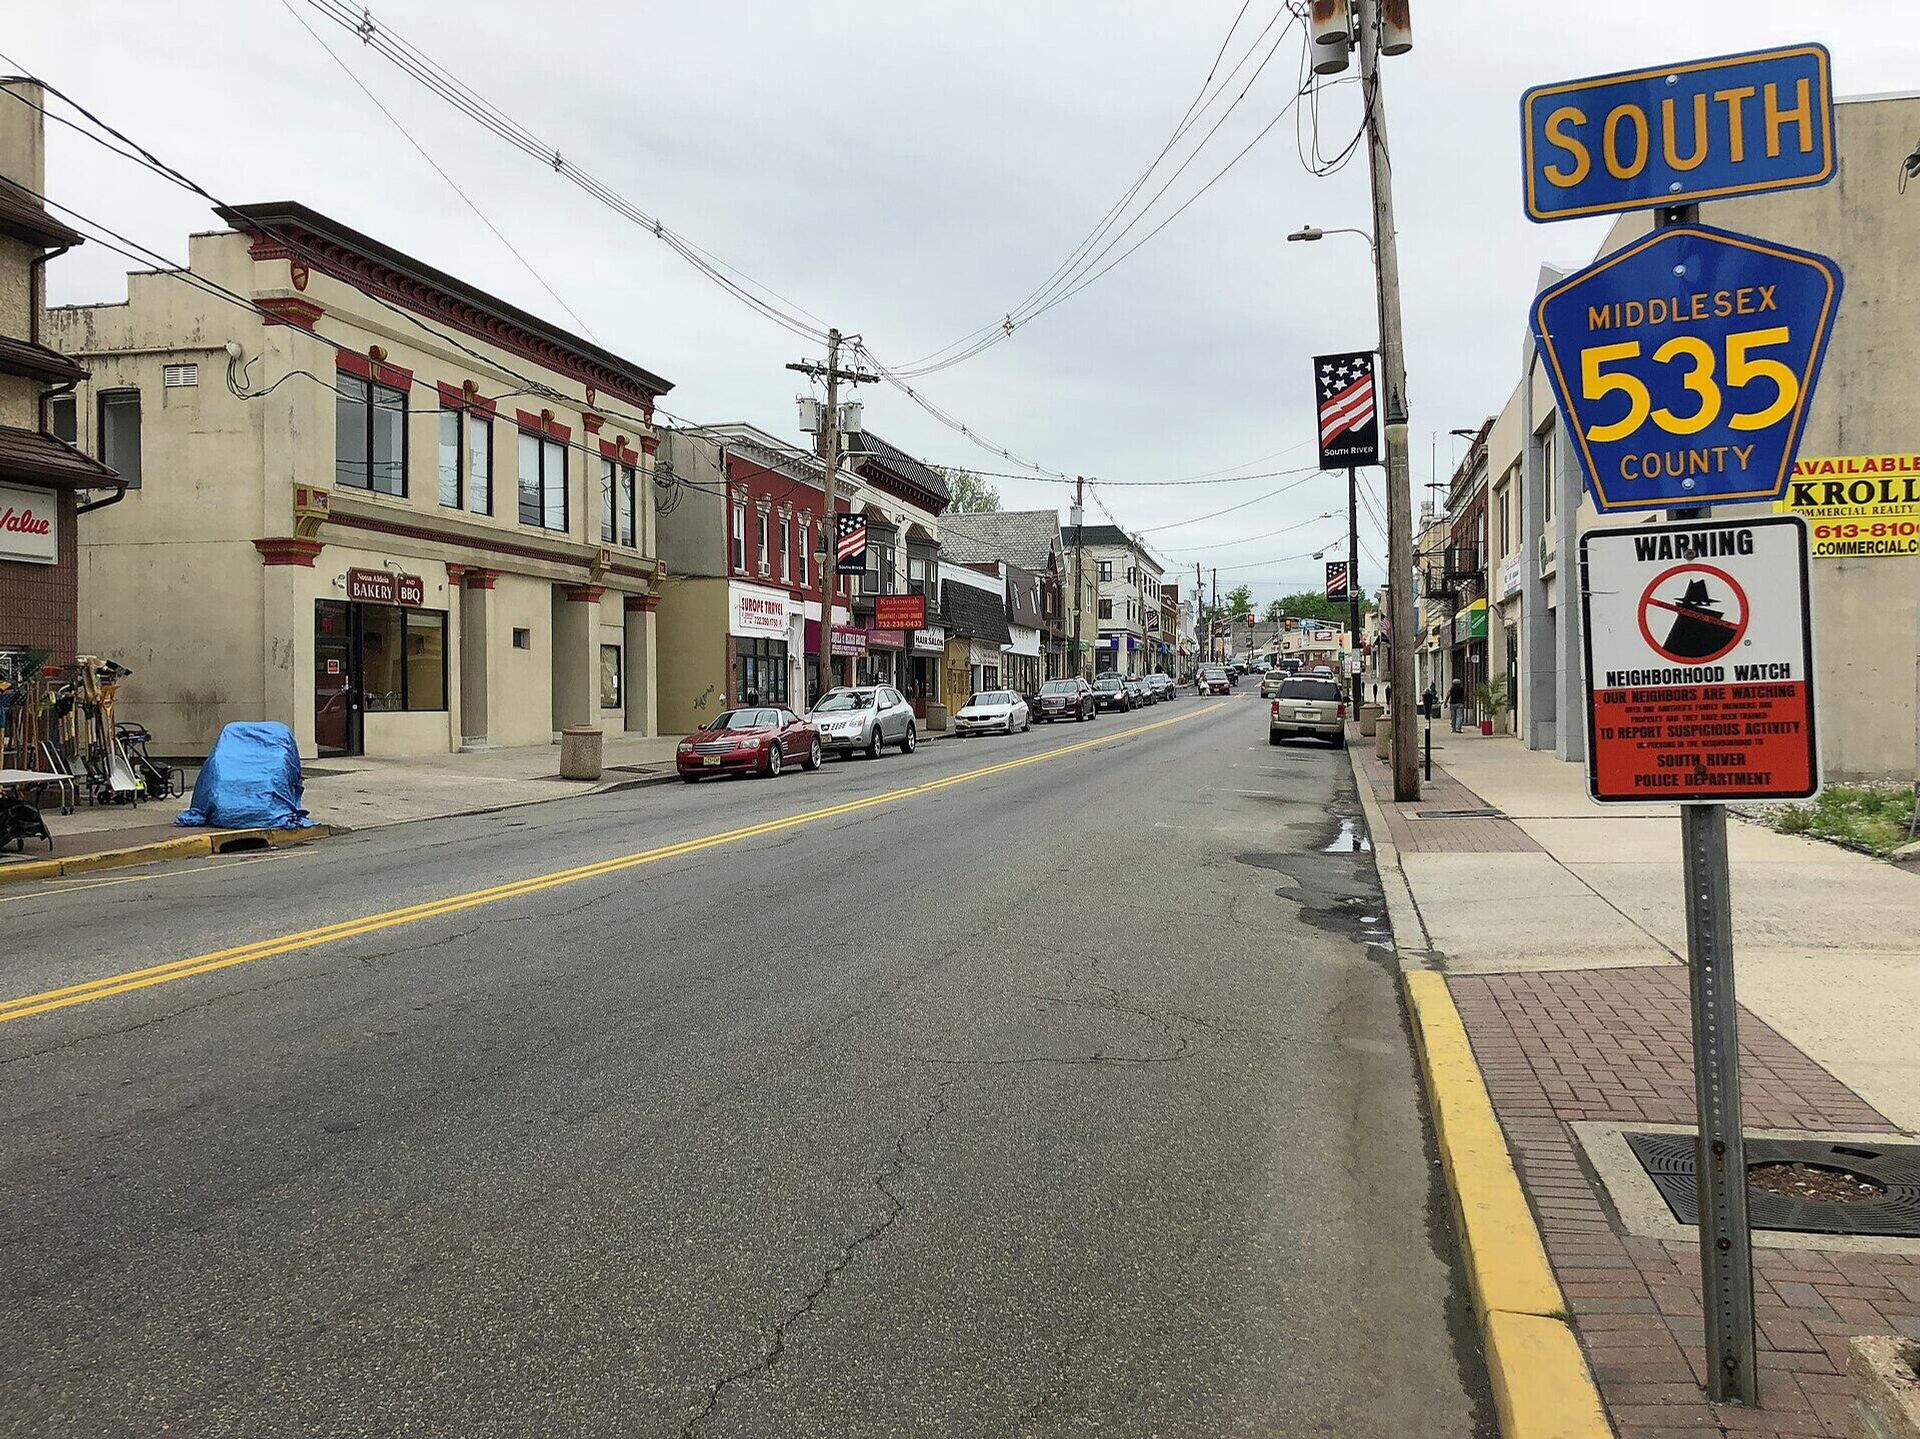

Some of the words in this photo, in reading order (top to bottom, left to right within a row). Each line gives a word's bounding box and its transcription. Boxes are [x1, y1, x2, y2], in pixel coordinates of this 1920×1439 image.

[1542, 78, 1813, 188] SOUTH
[1588, 285, 1777, 331] MIDDLESEX
[1580, 326, 1799, 442] 535
[1324, 448, 1349, 457] SOUTH
[1350, 446, 1374, 454] RIVER
[1619, 444, 1755, 480] COUNTY
[1793, 457, 1920, 475] AVAILABLE
[1790, 479, 1920, 506] KROLL
[1791, 506, 1867, 517] OMMERCIAL
[1872, 505, 1914, 515] REALTY
[1814, 522, 1920, 539] 613-810
[1634, 529, 1754, 561] WARNING
[353, 582, 393, 600] BAKERY
[401, 586, 421, 604] BBQ
[741, 597, 764, 613] EUROPE
[764, 600, 783, 616] TRAVEL
[915, 634, 928, 645] HAIR
[928, 636, 944, 648] SALON
[1606, 666, 1725, 687] NEIGHBORHOOD
[1734, 663, 1791, 681] WATCH
[1603, 691, 1627, 704] OUR
[1632, 688, 1698, 703] NEIGHBORS
[1702, 687, 1726, 700] ARE
[1732, 684, 1796, 699] WATCHING
[1600, 727, 1614, 740] TO
[1618, 725, 1663, 739] REPORT
[1667, 723, 1740, 737] SUSPICIOUS
[1745, 721, 1801, 736] ACTIVITY
[1657, 755, 1699, 767] SOUTH
[1706, 753, 1746, 766] RIVER
[1634, 773, 1679, 787] POLICE
[1685, 772, 1772, 786] DEPARTMENT
